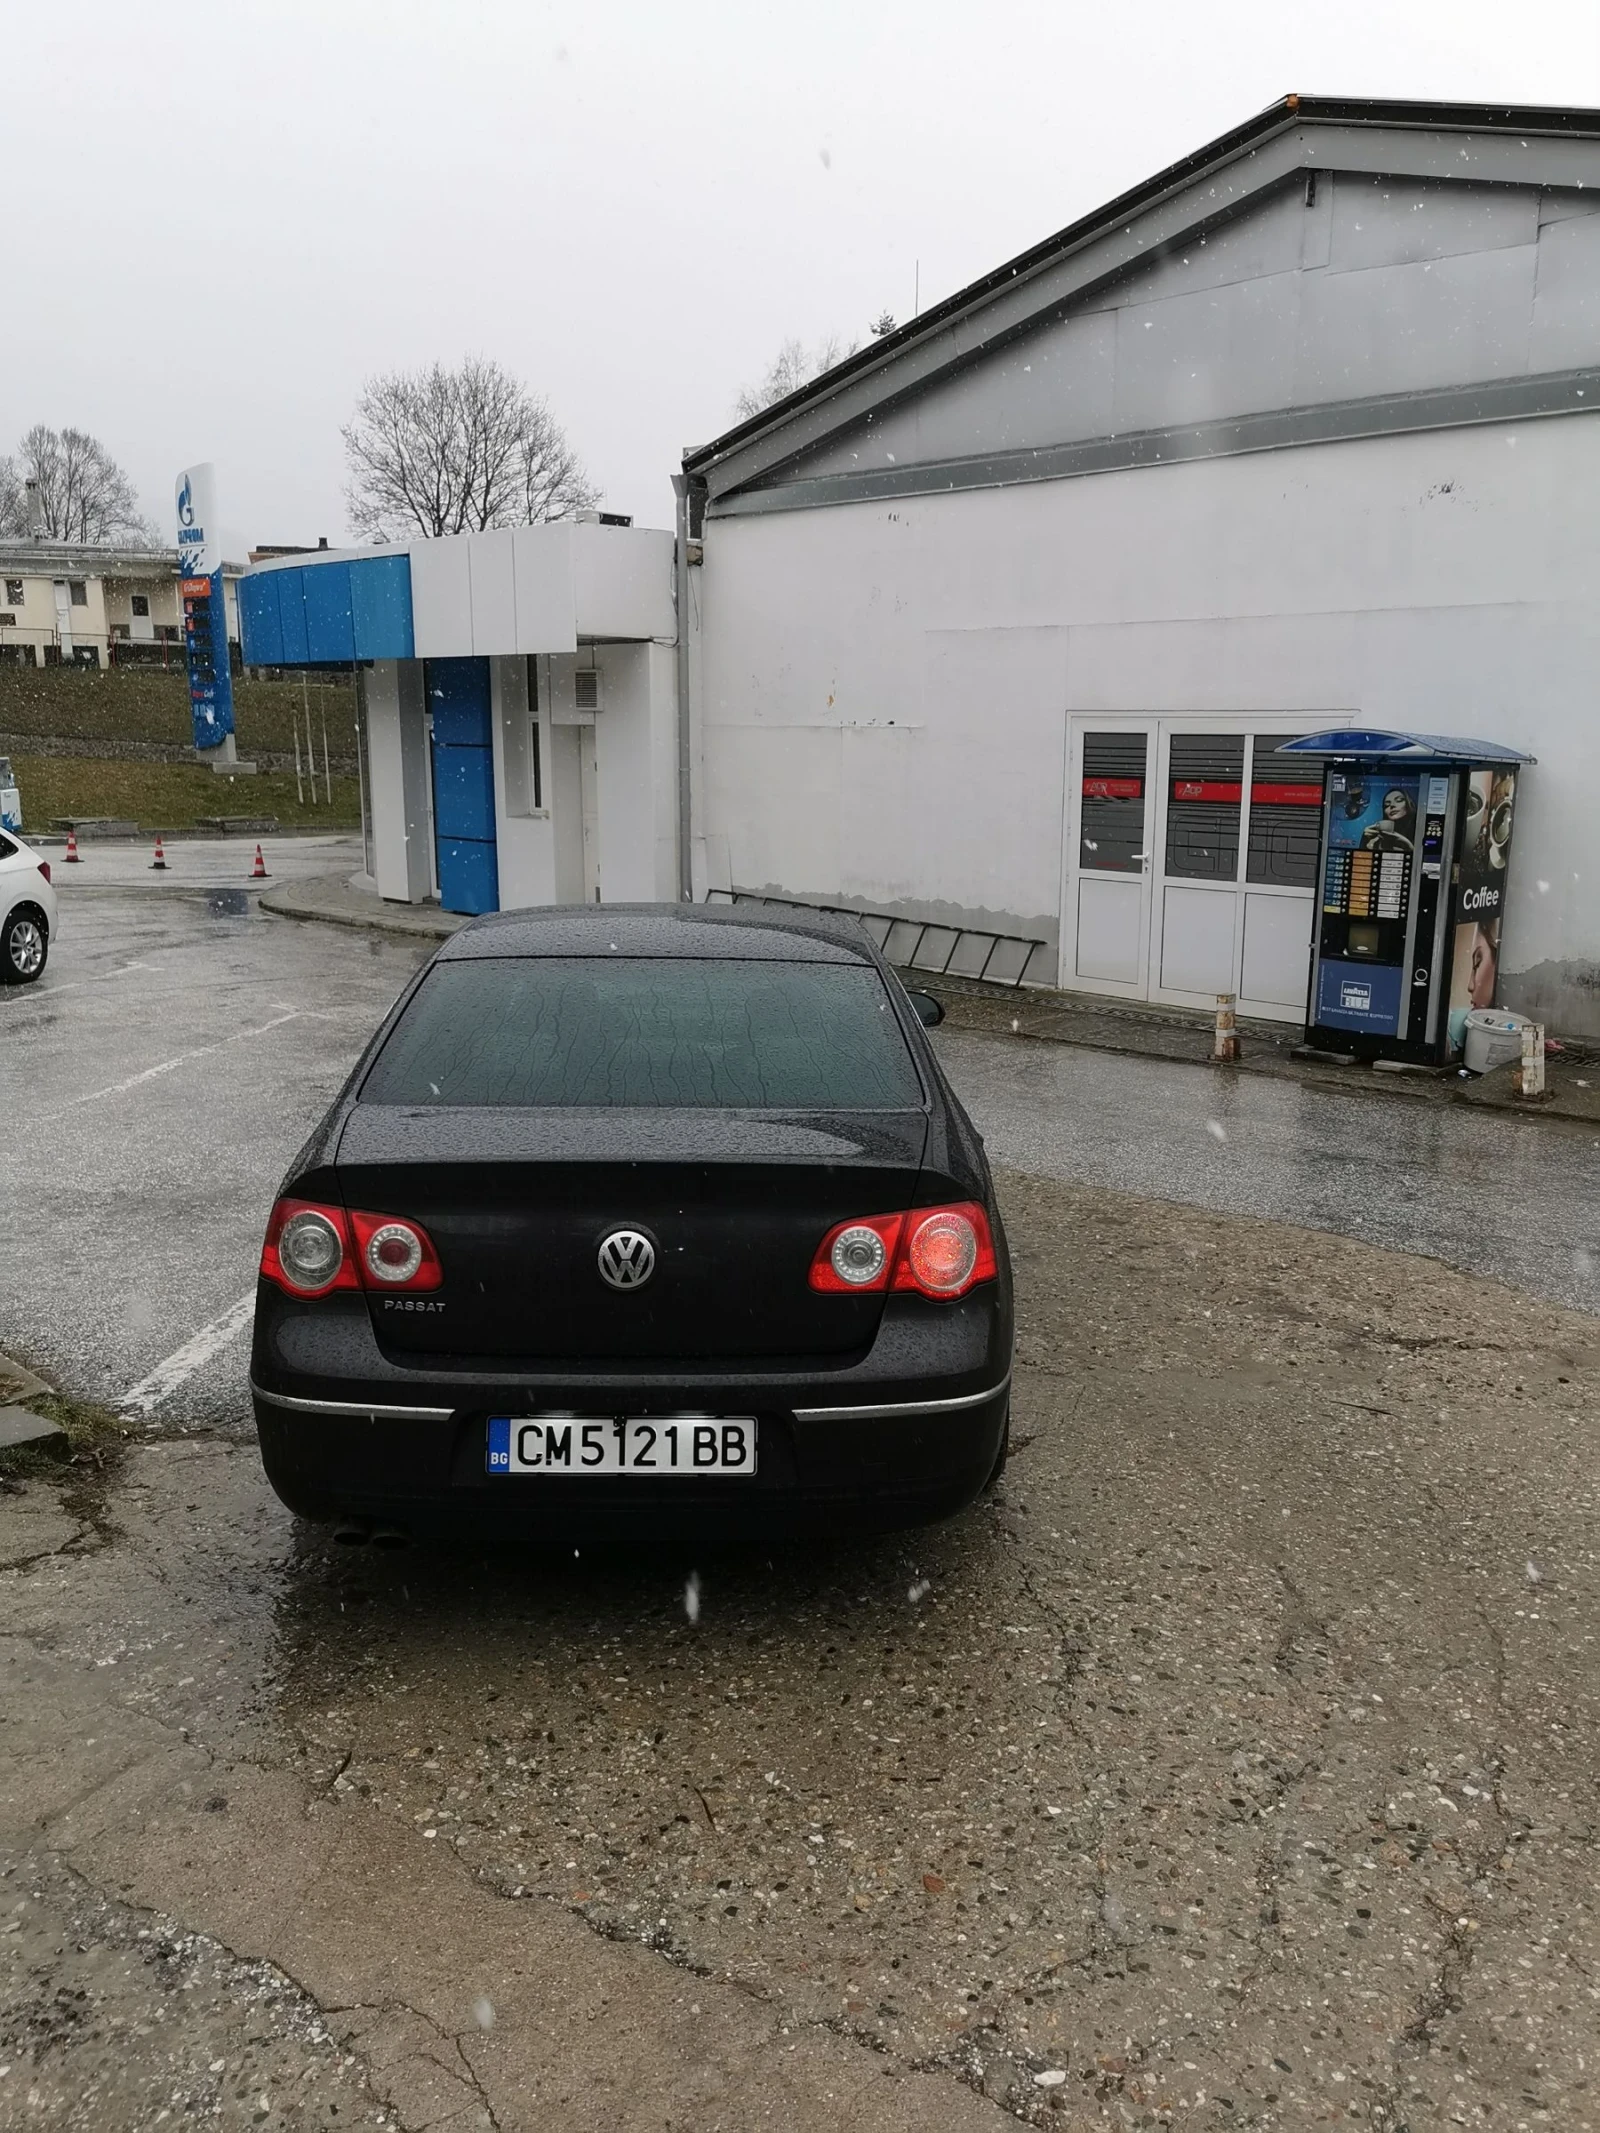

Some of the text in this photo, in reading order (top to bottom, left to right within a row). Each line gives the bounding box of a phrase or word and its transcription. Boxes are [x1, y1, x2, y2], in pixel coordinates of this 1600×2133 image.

[1463, 886, 1499, 910] Coffee
[384, 1300, 446, 1313] PASSAT
[491, 1453, 508, 1465] BG
